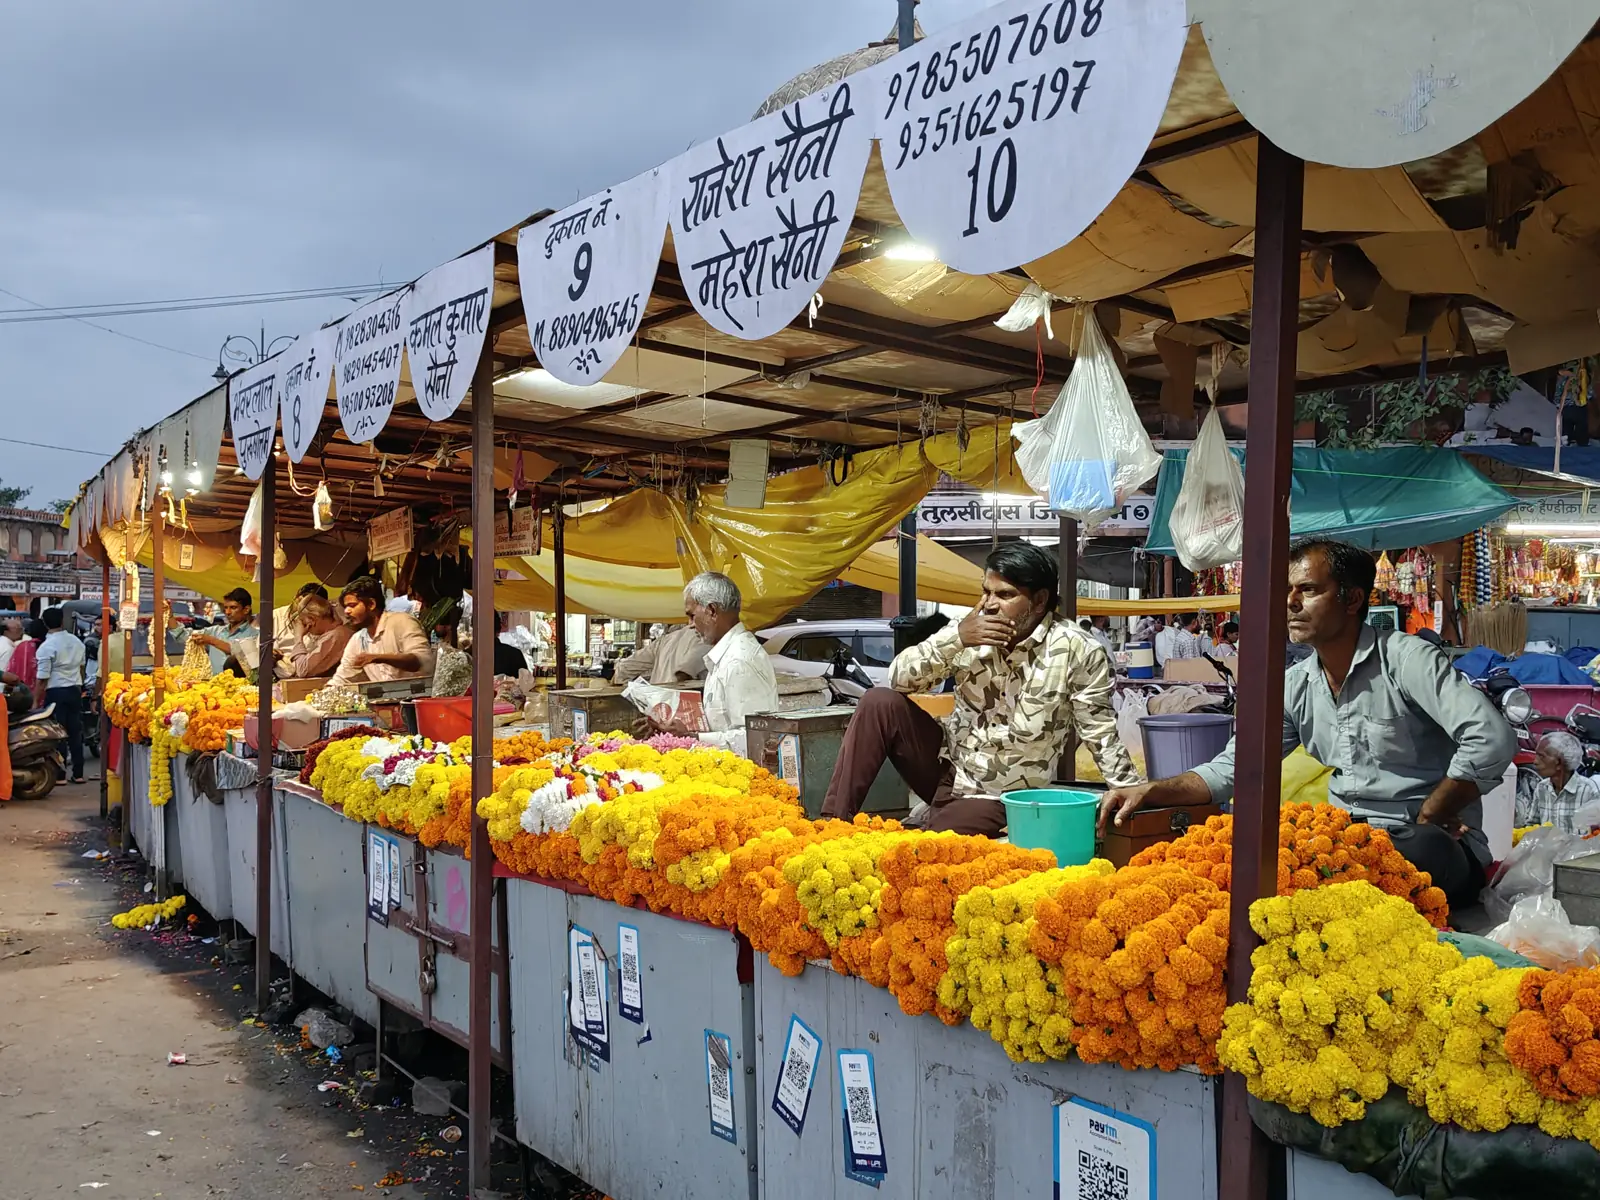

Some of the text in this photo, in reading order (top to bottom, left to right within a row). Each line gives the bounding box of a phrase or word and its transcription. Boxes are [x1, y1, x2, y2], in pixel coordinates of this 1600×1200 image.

[884, 0, 1104, 120] 9785507608
[766, 82, 855, 199] सैनी
[895, 59, 1097, 171] 9351625197
[962, 137, 1018, 238] 10
[544, 207, 593, 260] दुकान
[690, 189, 840, 331] महेश सैनी
[567, 241, 593, 302] 9
[408, 286, 489, 355] कमल कुमार
[549, 292, 641, 352] 8890496545
[424, 350, 459, 409] सैनी
[292, 394, 302, 450] 8
